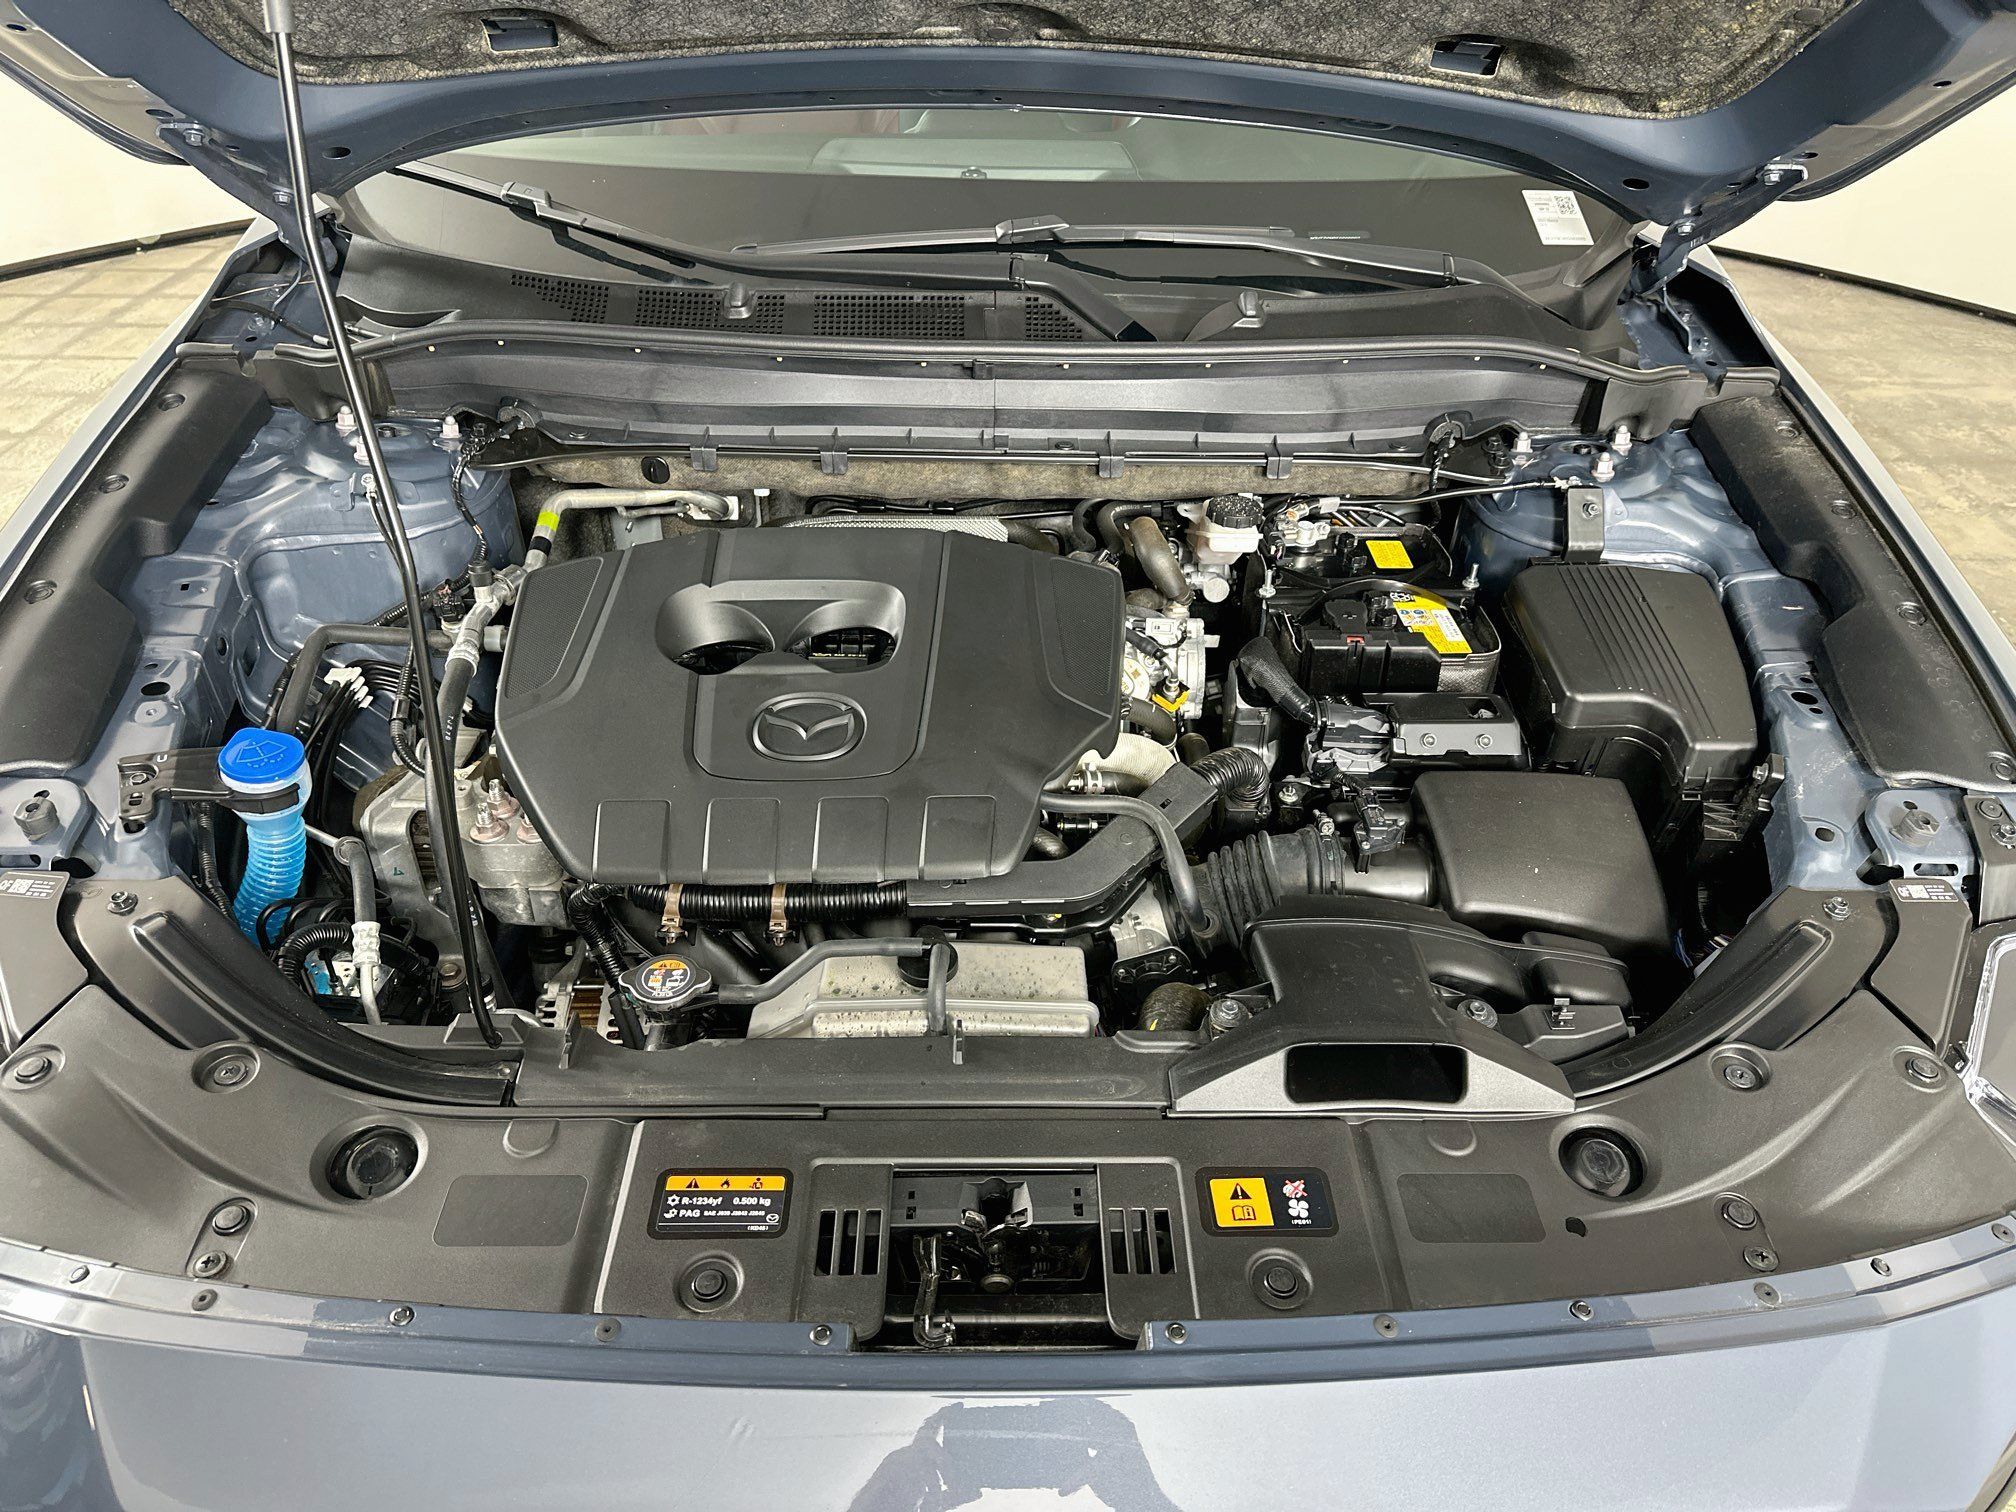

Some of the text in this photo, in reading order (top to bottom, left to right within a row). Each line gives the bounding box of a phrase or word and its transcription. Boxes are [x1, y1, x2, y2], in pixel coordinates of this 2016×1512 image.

[681, 1197, 771, 1206] R-1234yf 0.500 kg
[679, 1209, 701, 1218] PAG
